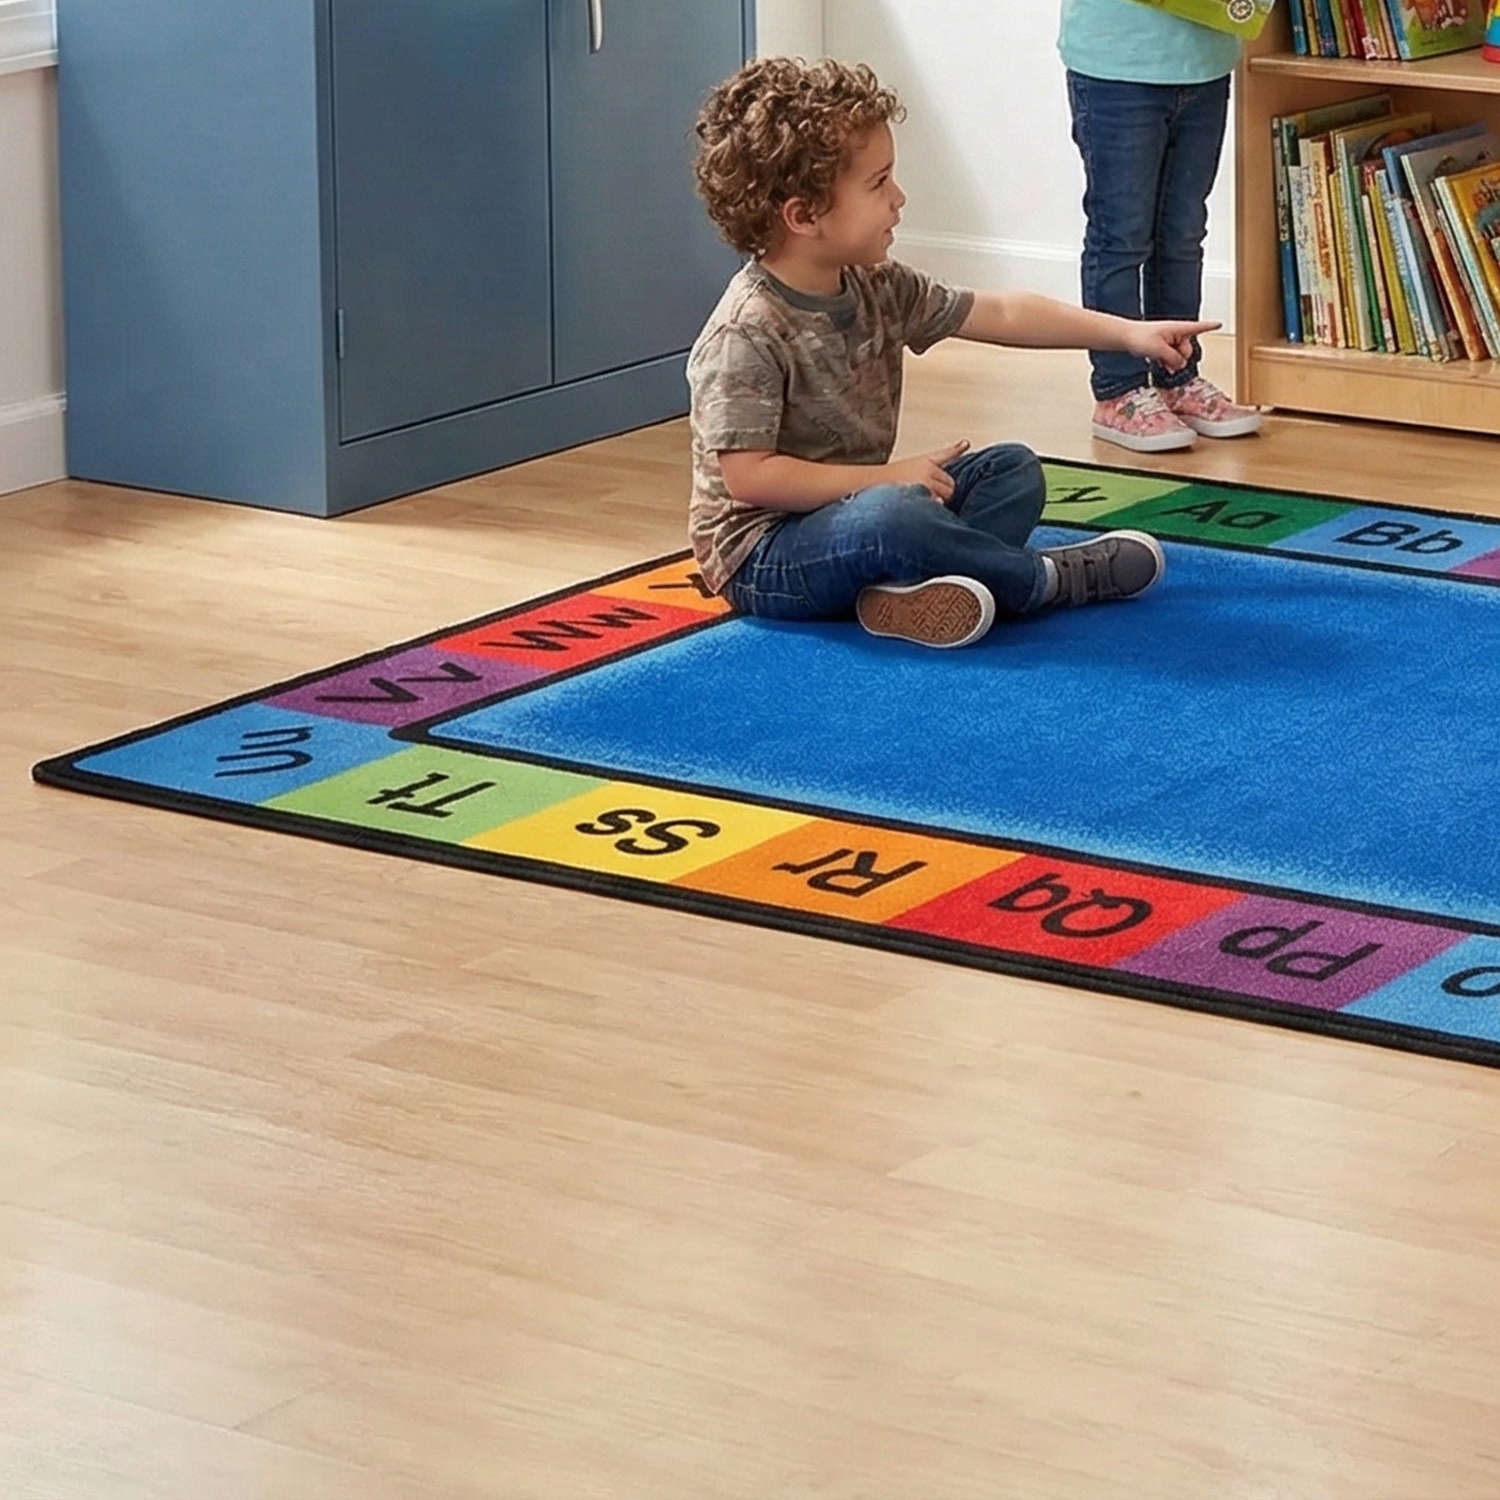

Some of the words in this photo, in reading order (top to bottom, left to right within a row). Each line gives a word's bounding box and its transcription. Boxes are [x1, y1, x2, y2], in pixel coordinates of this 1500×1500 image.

[1167, 499, 1284, 530] Aa
[1334, 521, 1464, 555] Bb
[480, 605, 659, 651] Ww
[366, 772, 497, 818] Tt
[575, 809, 722, 856] Ss
[772, 848, 927, 899] Rr
[1219, 920, 1383, 982] Pp
